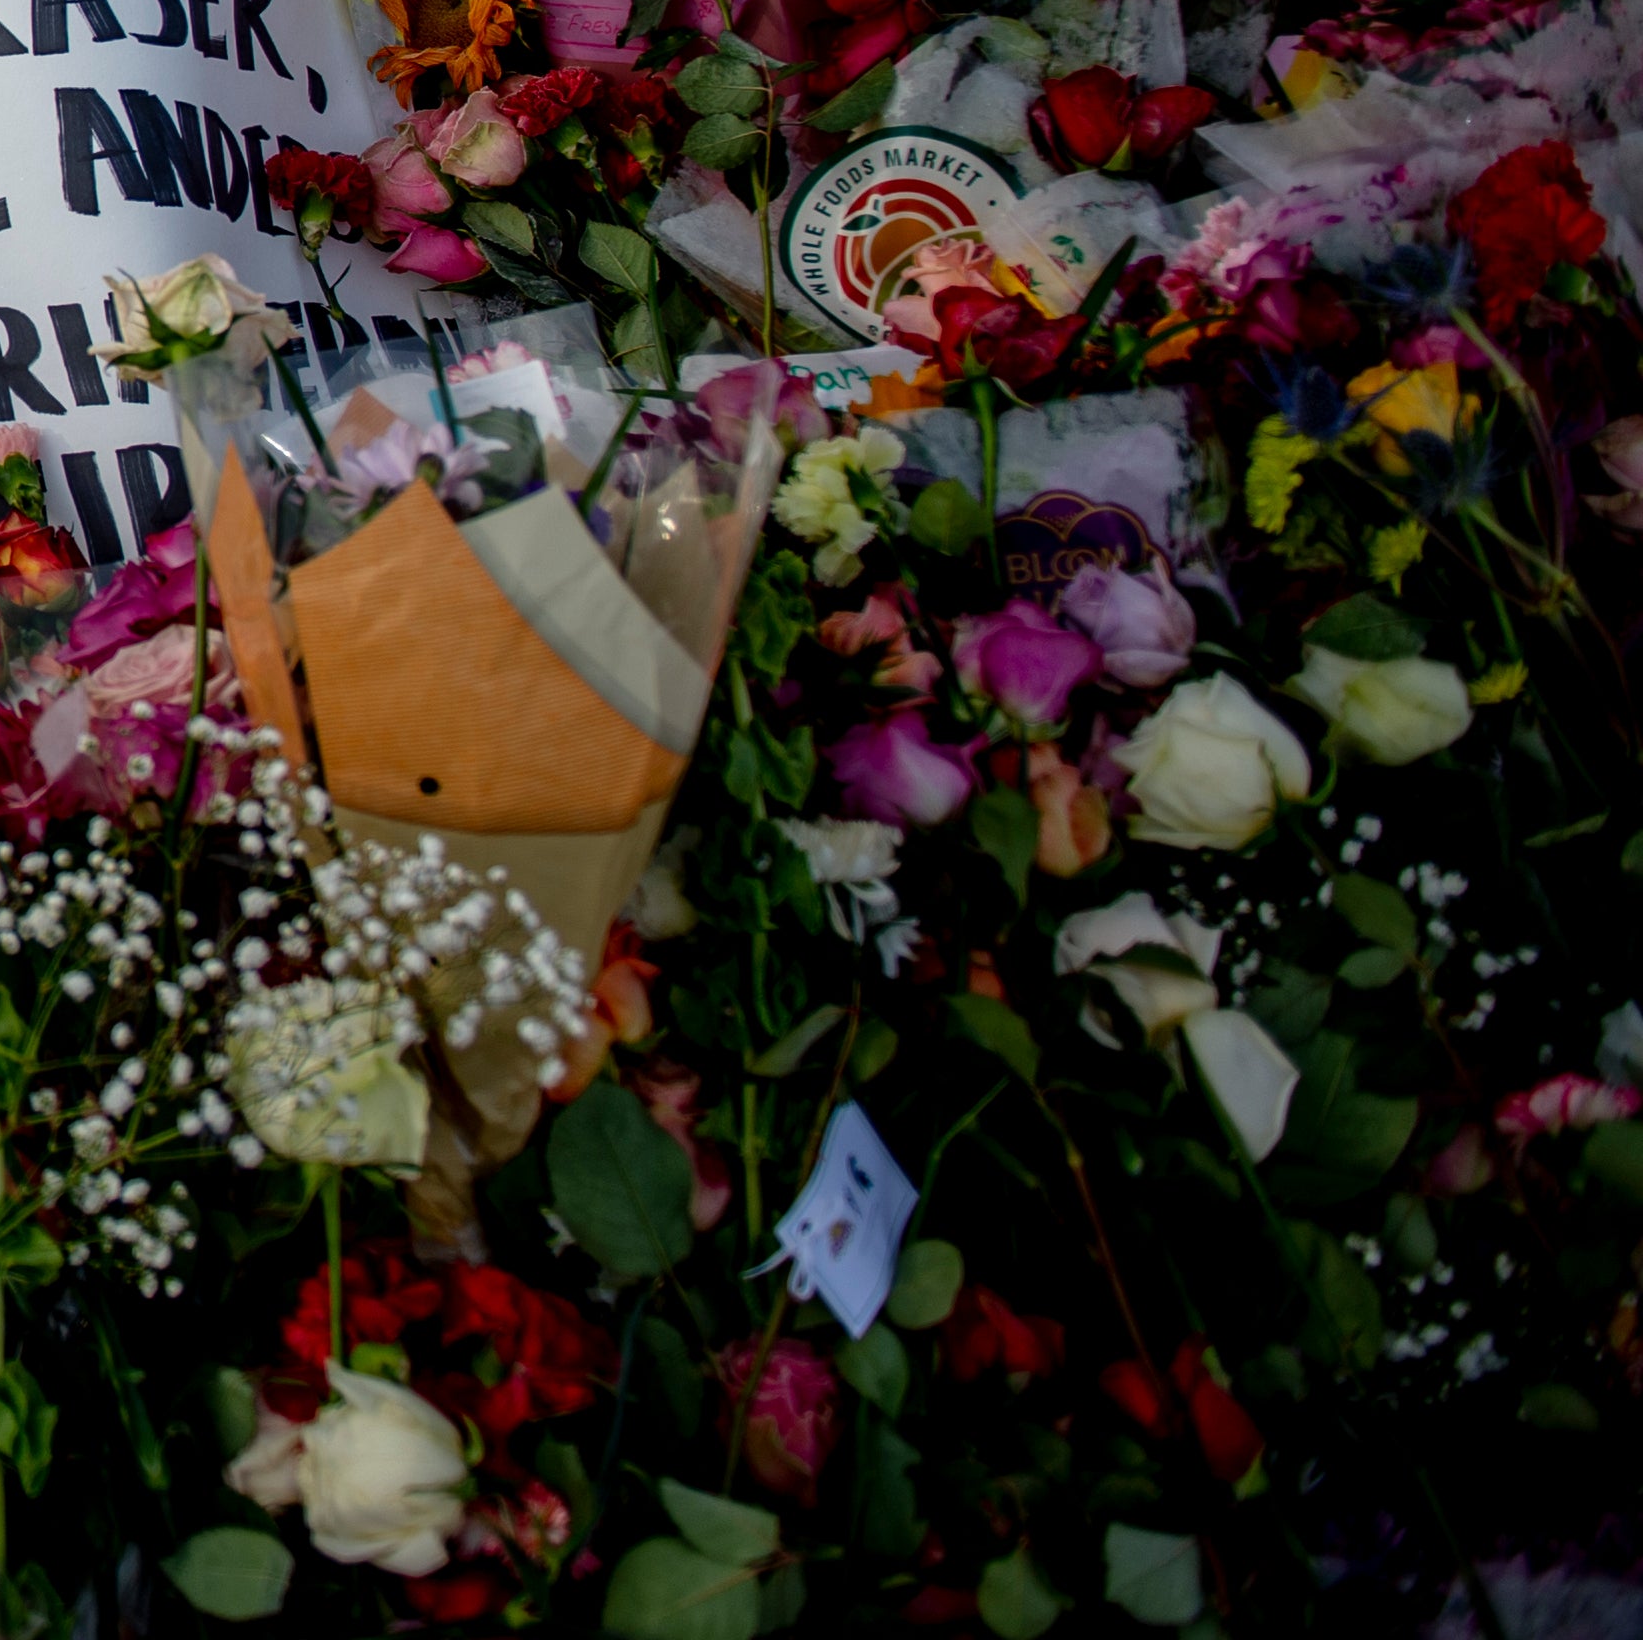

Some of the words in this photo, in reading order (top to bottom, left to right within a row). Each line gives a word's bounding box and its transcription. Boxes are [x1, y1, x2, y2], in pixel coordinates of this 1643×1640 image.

[815, 158, 875, 217] FOODS
[884, 147, 984, 188] MARKET
[802, 224, 829, 296] WHOLE
